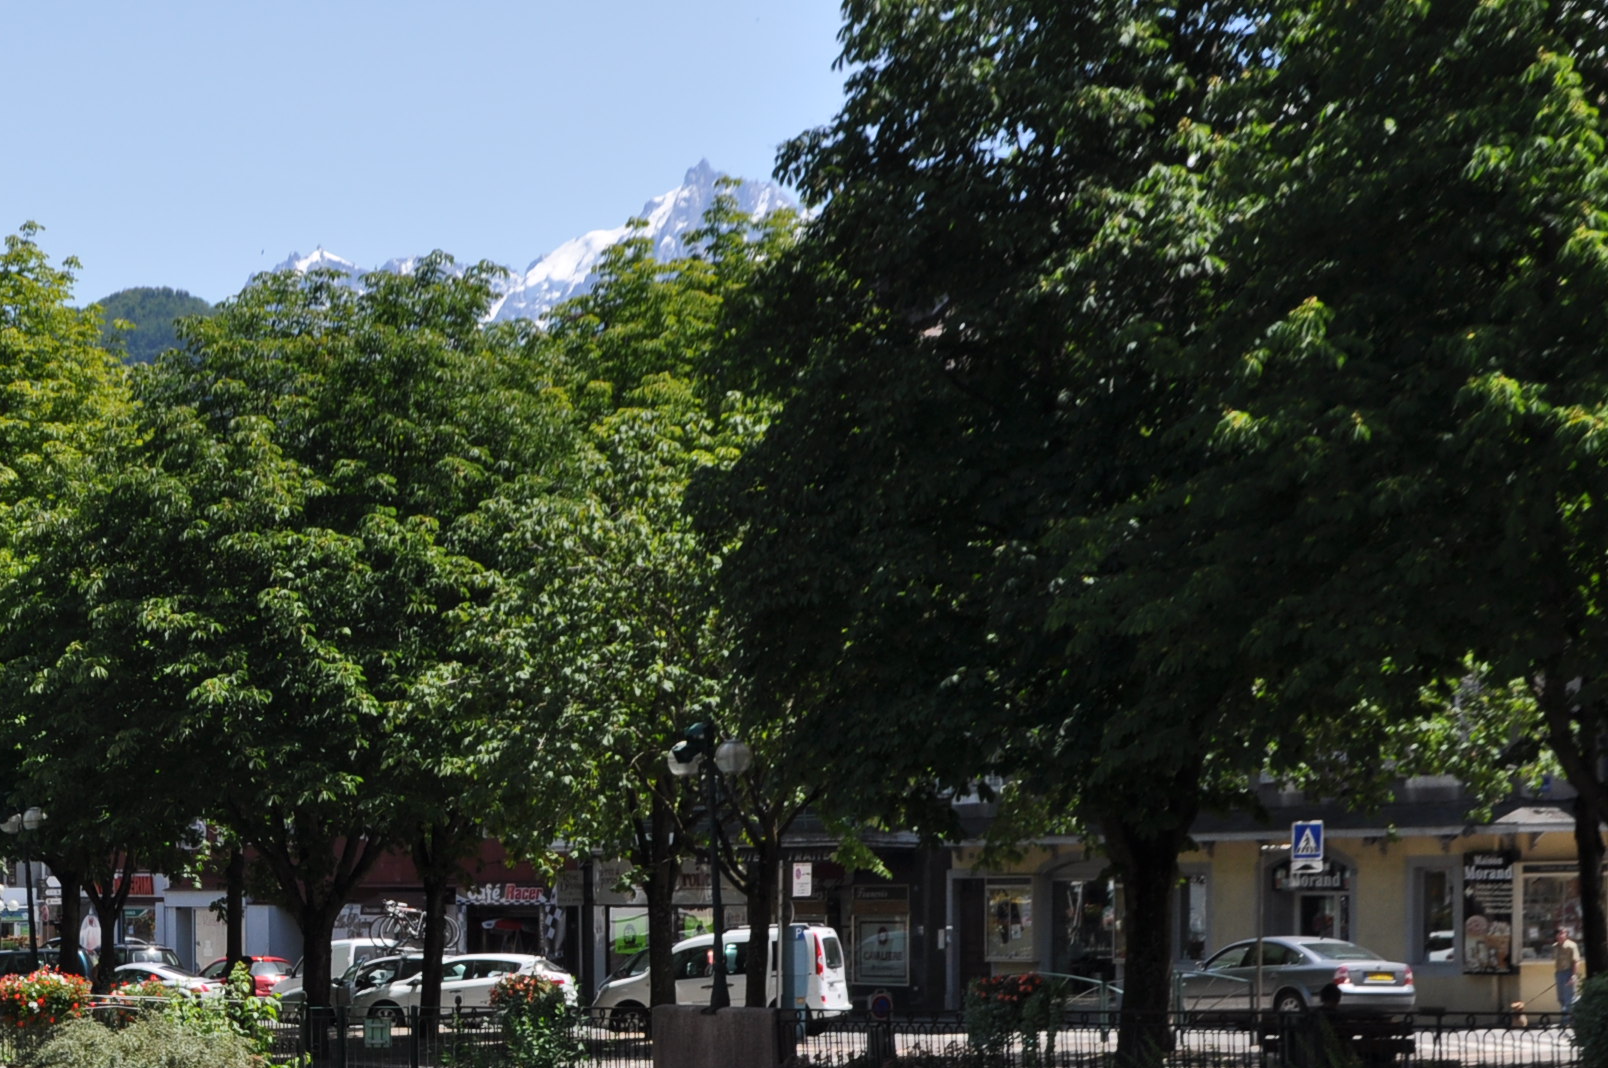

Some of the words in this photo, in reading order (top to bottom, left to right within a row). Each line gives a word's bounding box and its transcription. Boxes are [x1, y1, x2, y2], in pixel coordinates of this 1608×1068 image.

[1465, 865, 1512, 880] Morand
[467, 883, 501, 903] Café
[505, 883, 544, 901] Racer
[795, 927, 803, 940] P
